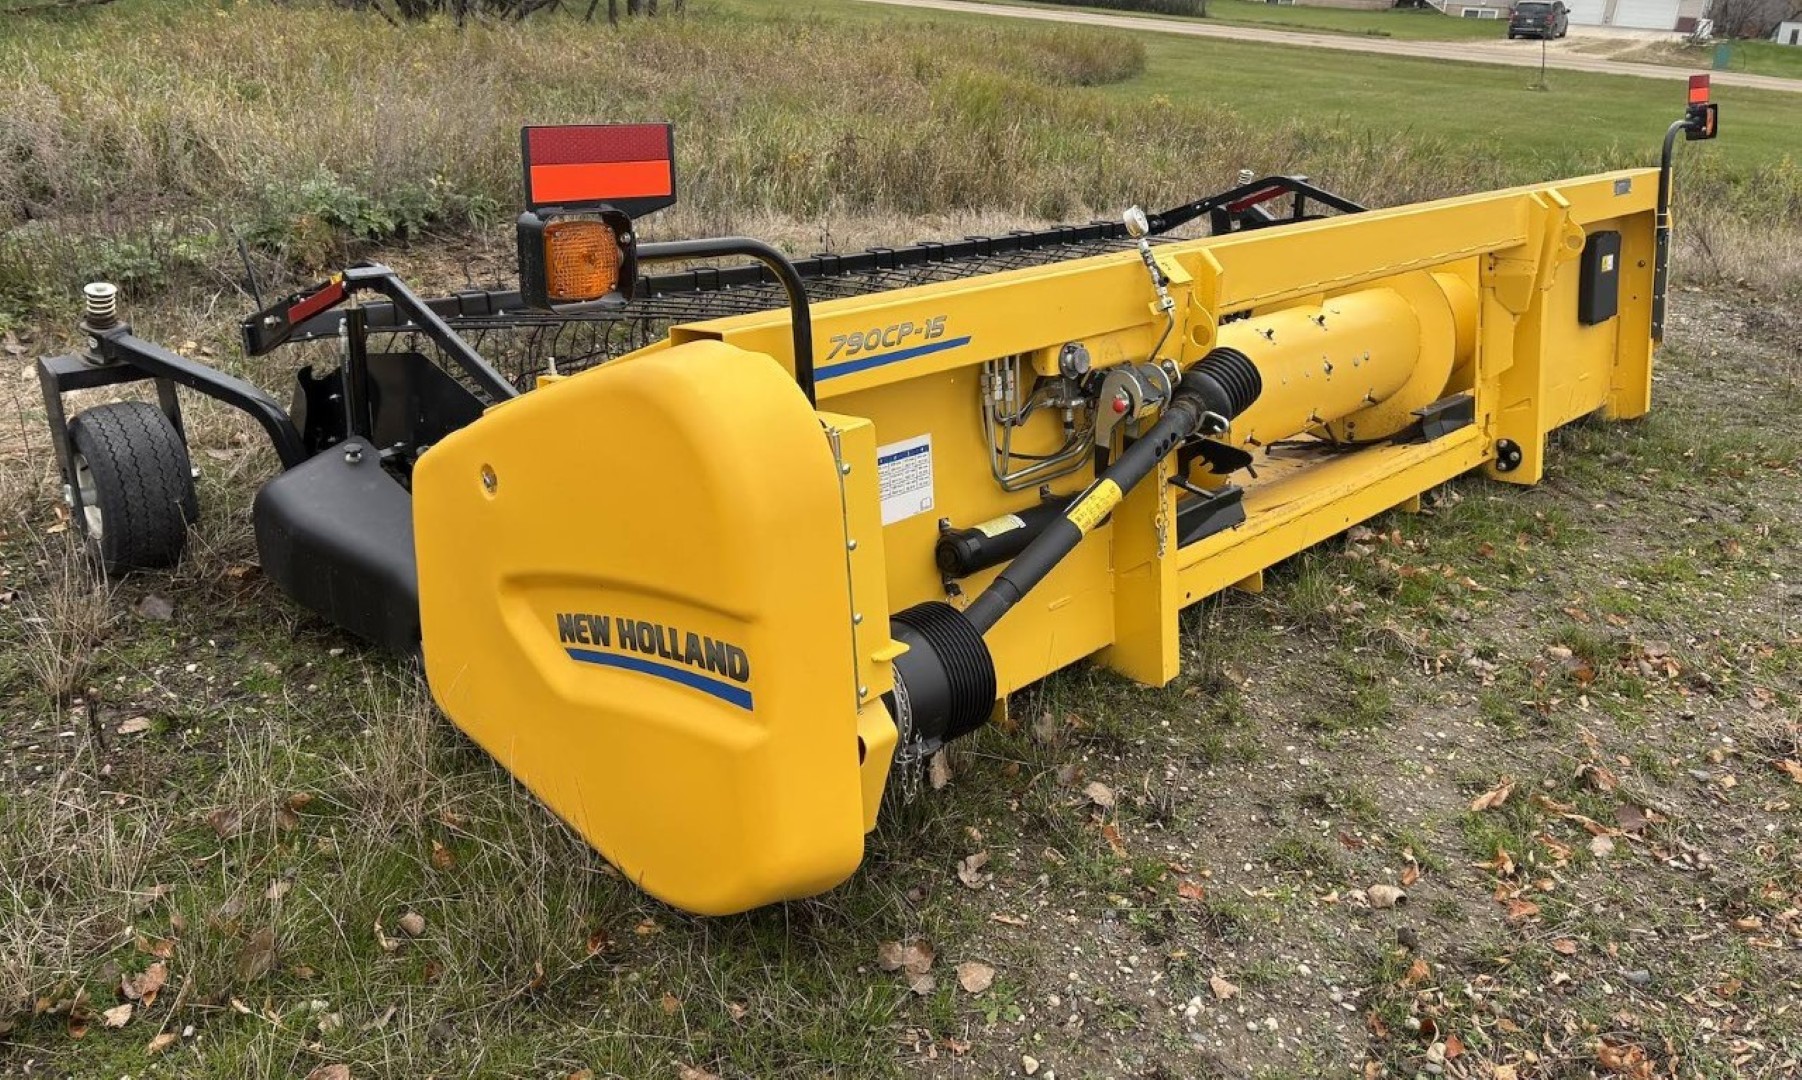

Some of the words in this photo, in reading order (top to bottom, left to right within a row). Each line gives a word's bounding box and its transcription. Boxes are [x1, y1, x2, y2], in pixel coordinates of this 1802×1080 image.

[826, 315, 948, 360] 790CP-15
[556, 613, 611, 647] NEW
[616, 617, 750, 683] HOLLAND
